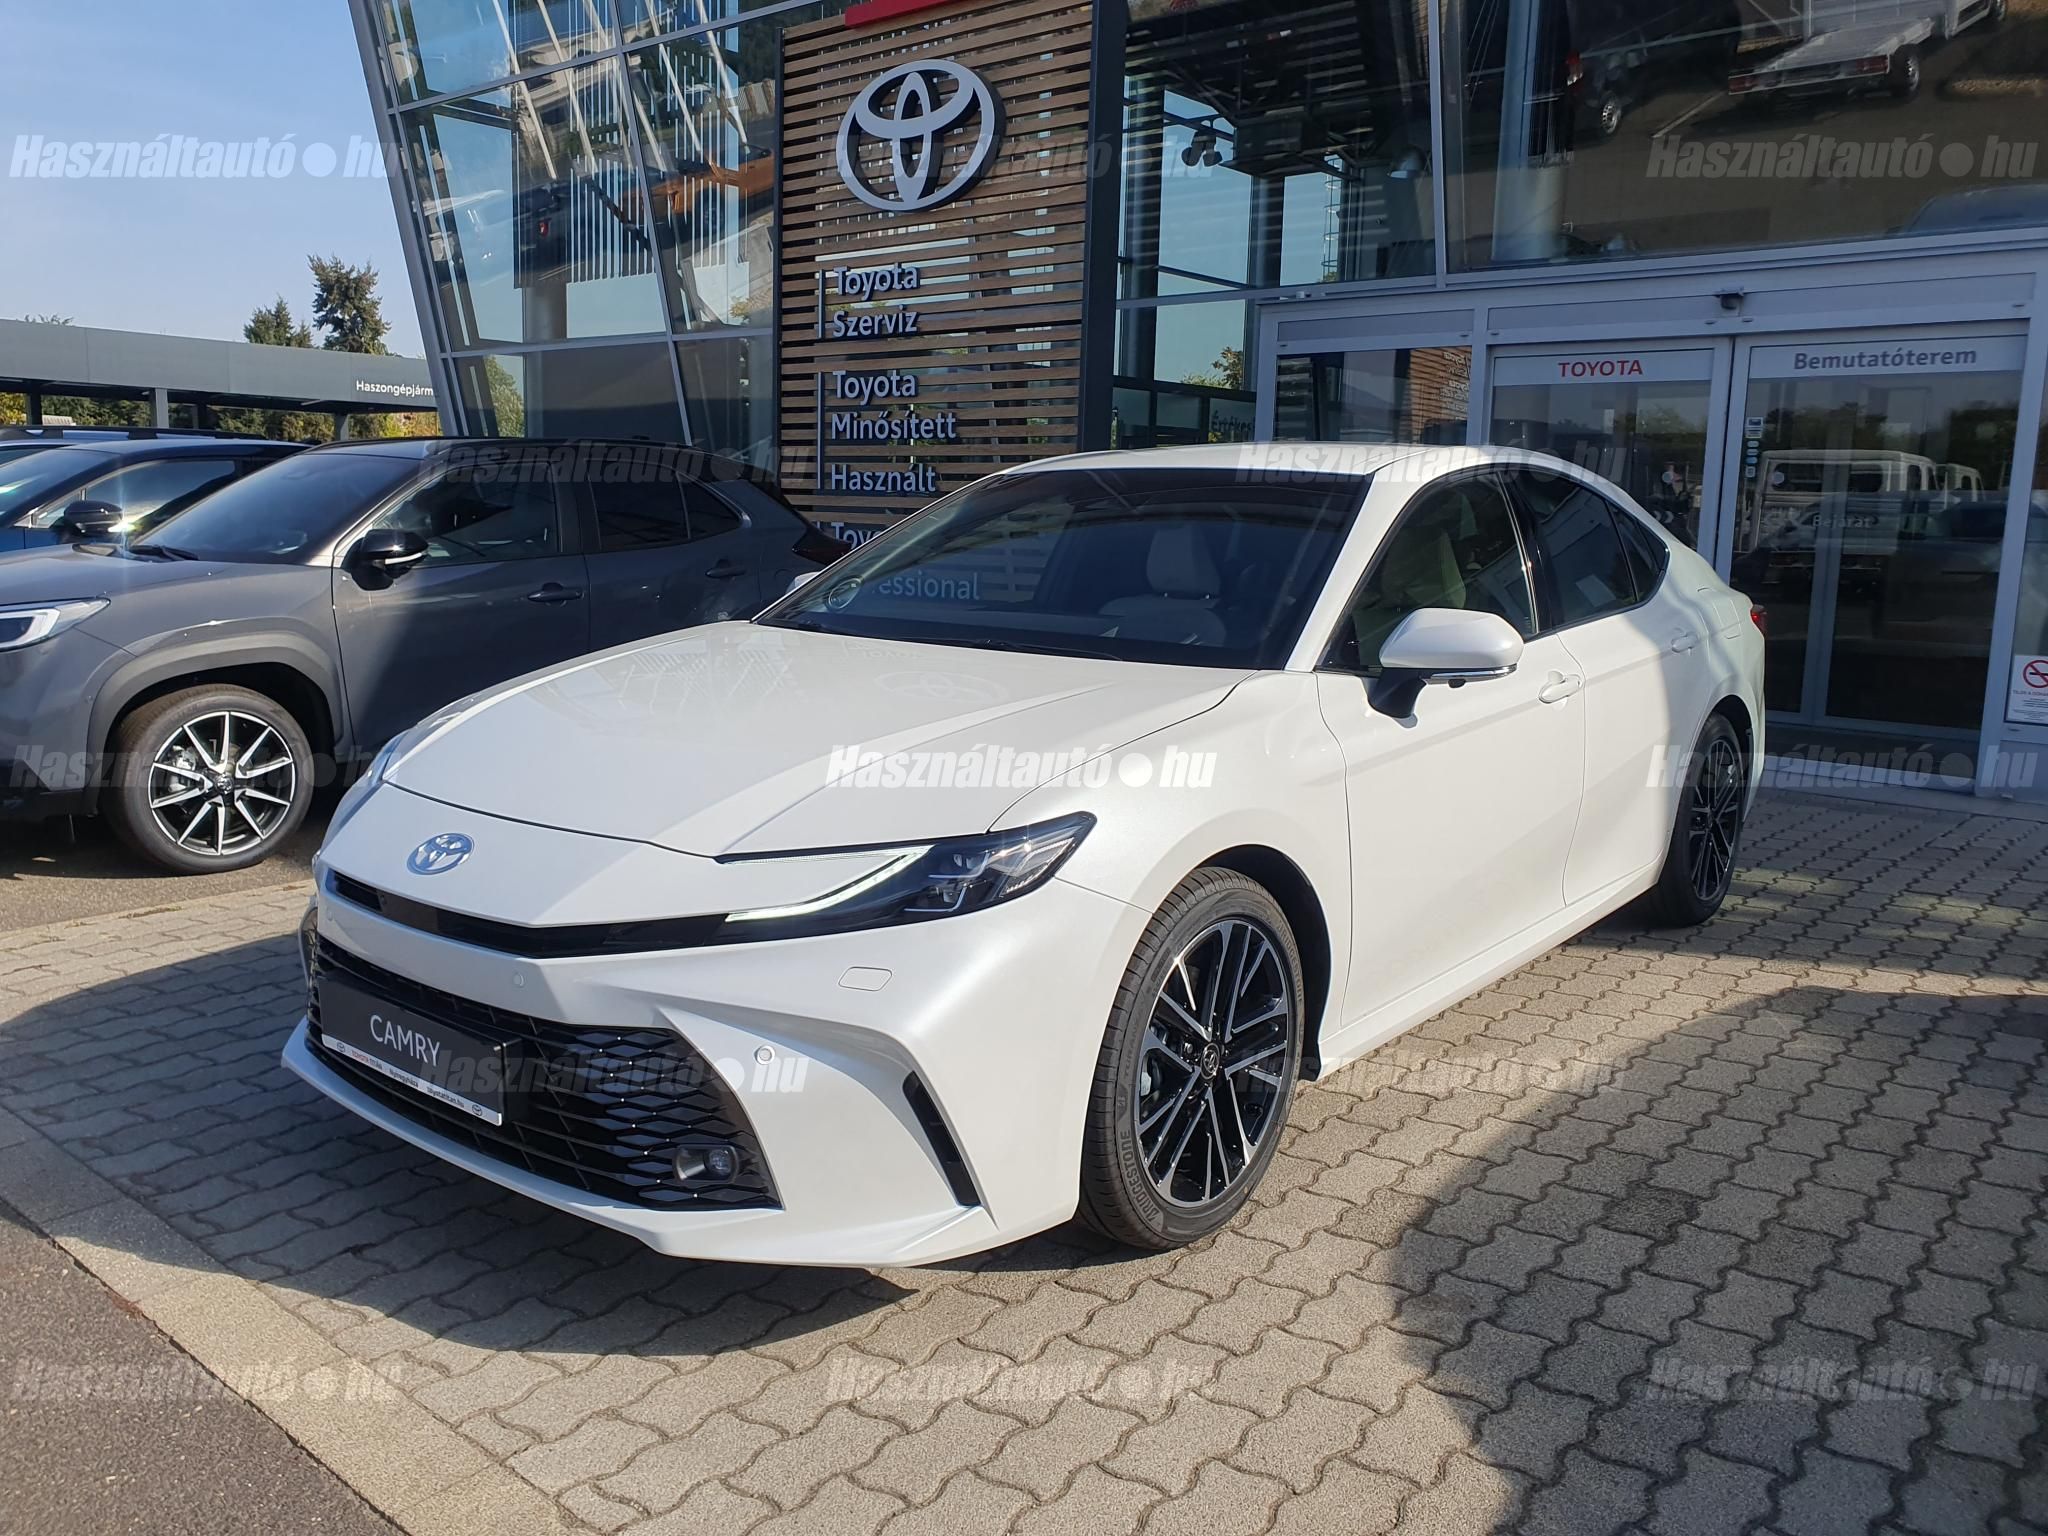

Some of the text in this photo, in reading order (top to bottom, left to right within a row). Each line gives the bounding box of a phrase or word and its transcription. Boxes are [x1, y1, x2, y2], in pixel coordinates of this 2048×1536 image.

[833, 263, 918, 300] Toyota
[833, 304, 917, 337] Szerviz
[1558, 360, 1643, 377] TOYOTA
[1794, 347, 1976, 369] Bemutatóterem
[832, 369, 916, 405] Toyota
[831, 410, 956, 439] Minősített
[831, 463, 936, 491] Használt
[873, 571, 979, 600] essional
[370, 1015, 440, 1067] CAMRY
